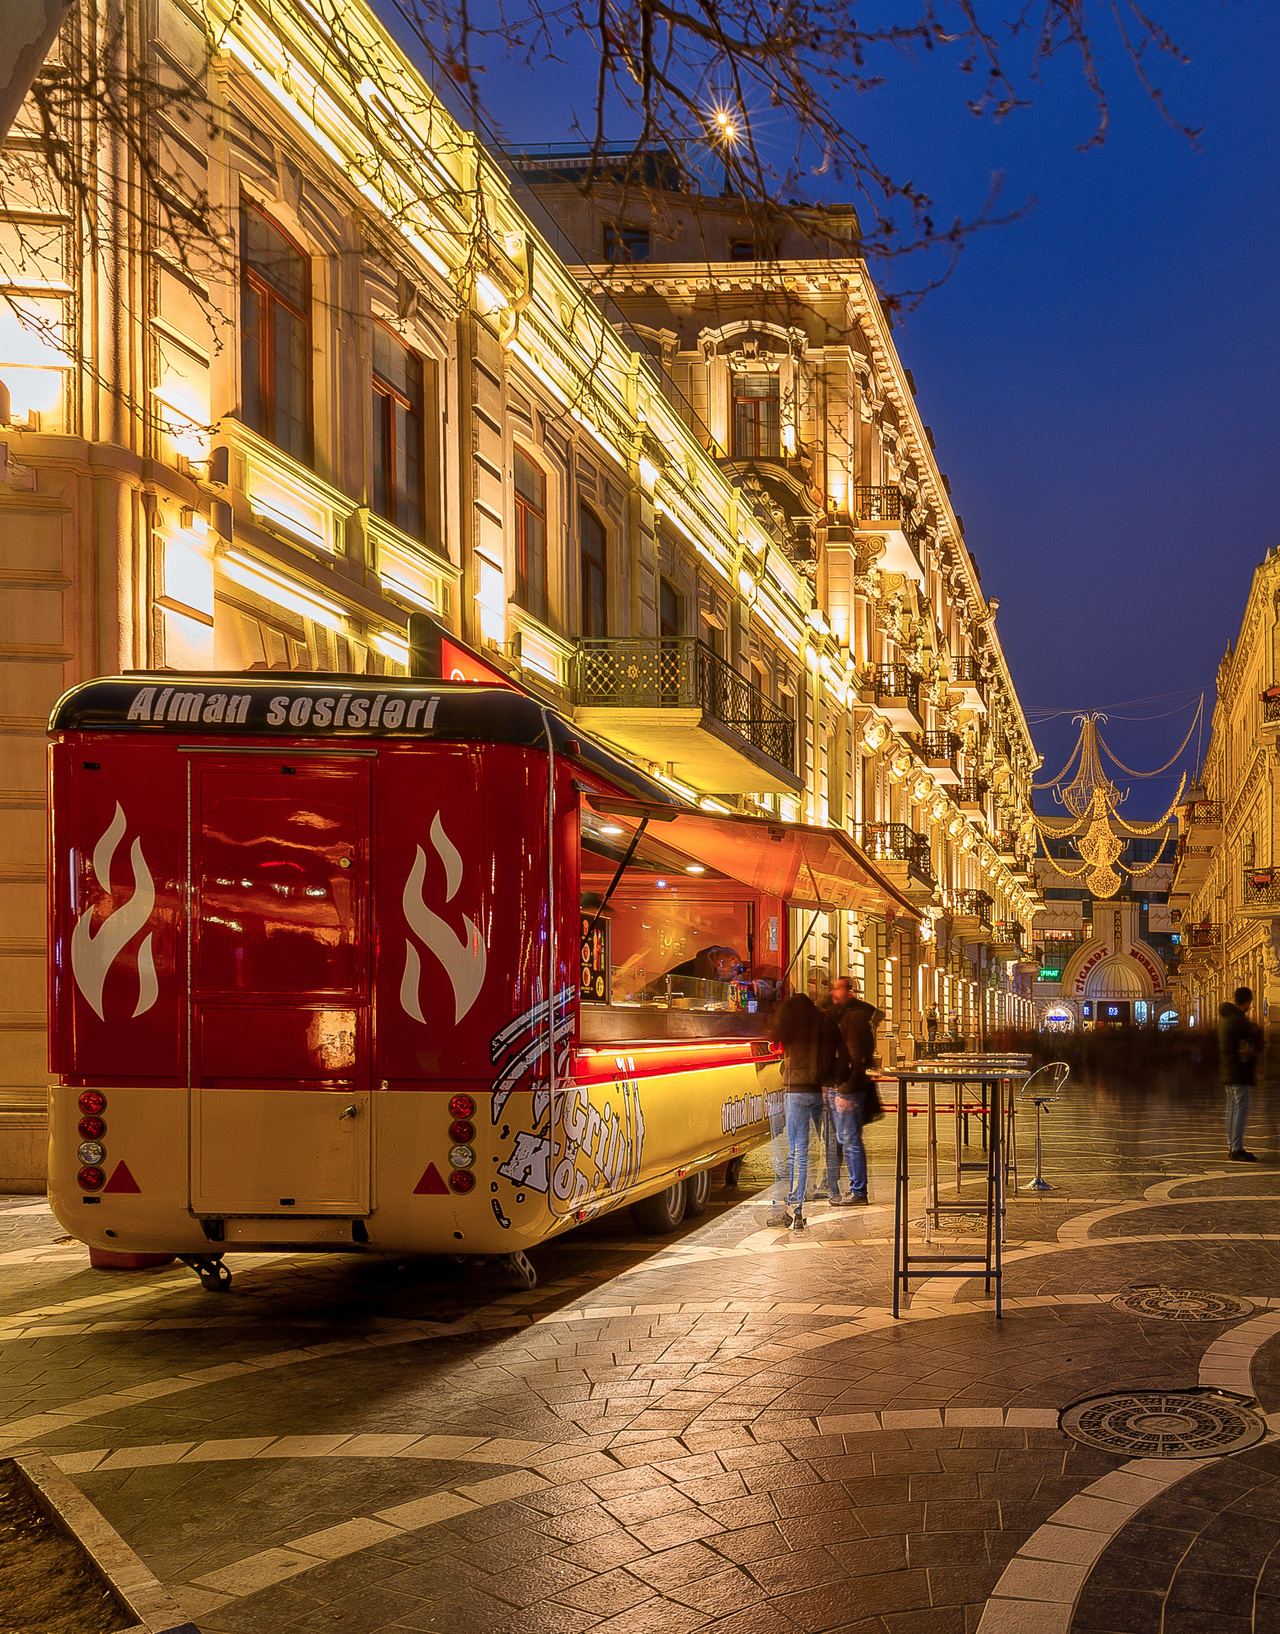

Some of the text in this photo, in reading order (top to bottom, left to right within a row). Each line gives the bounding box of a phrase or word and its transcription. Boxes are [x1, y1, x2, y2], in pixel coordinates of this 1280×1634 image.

[127, 687, 441, 729] Alman sosisləri
[1075, 947, 1109, 993] TİCARƏT
[562, 1083, 626, 1195] Grill
